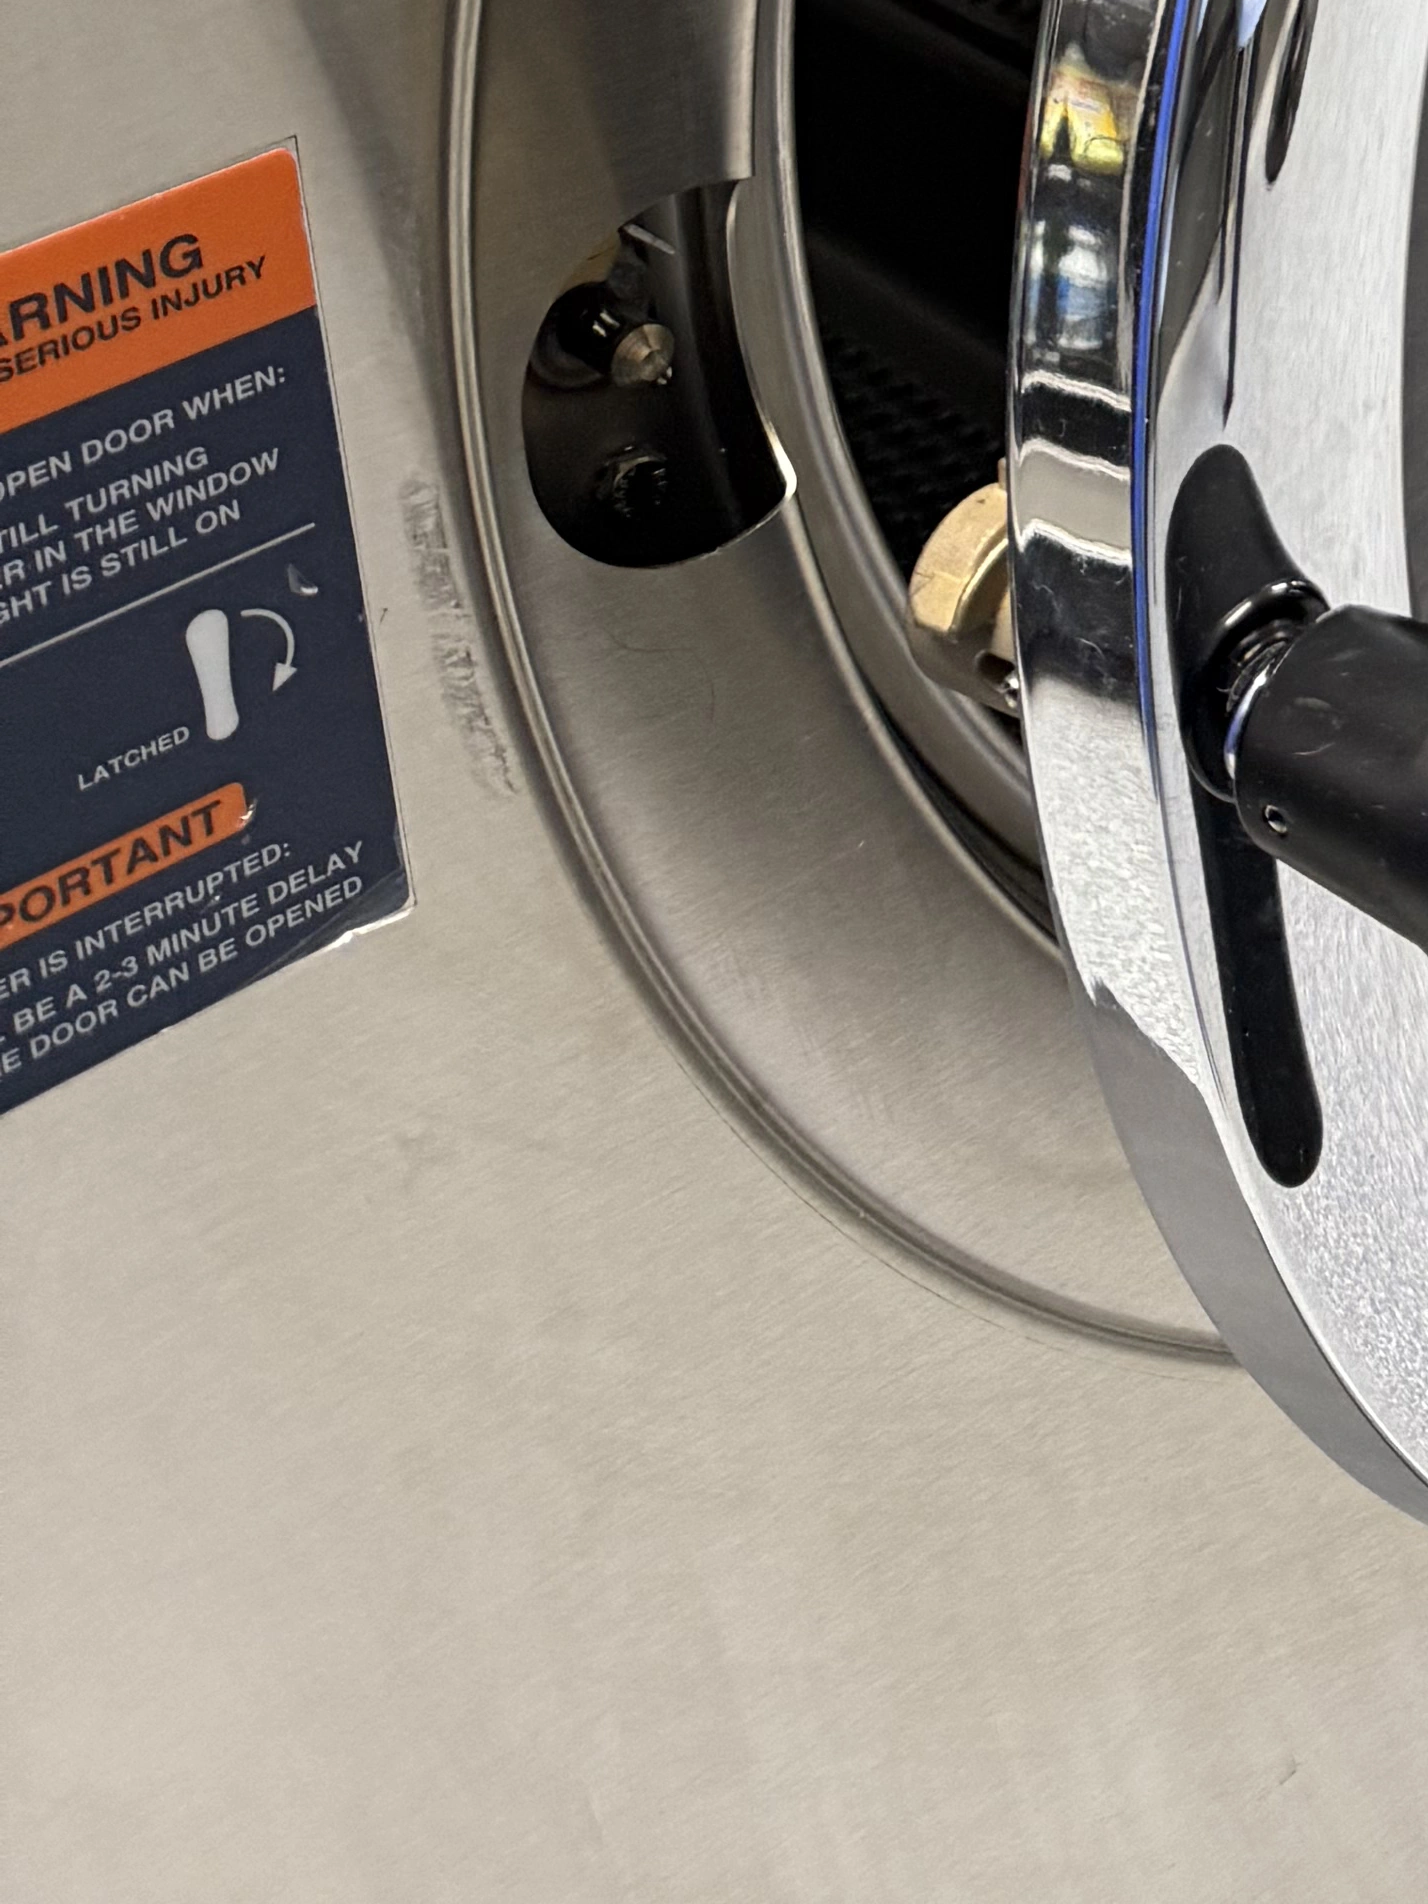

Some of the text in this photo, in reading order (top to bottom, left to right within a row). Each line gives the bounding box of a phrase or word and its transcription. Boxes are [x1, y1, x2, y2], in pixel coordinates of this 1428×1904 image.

[0, 233, 204, 347] RNING
[0, 255, 266, 382] SERIOUS INJURY
[0, 365, 286, 502] PEN DOOR WHEN:
[64, 446, 209, 522] TURNING
[0, 447, 279, 590] R IN THE WINDOW
[61, 565, 93, 596] IS
[101, 526, 188, 578] STILL
[195, 499, 241, 534] ON
[78, 725, 190, 791] LATCHED
[13, 840, 363, 1034] BE A 2-3 MINUTE DELAY
[30, 998, 119, 1059] DOOR
[127, 962, 190, 1008] CAN
[199, 937, 240, 974] BE
[245, 875, 363, 948] OPENED
[39, 950, 69, 979] IS
[76, 842, 291, 961] INTERRUPTED:
